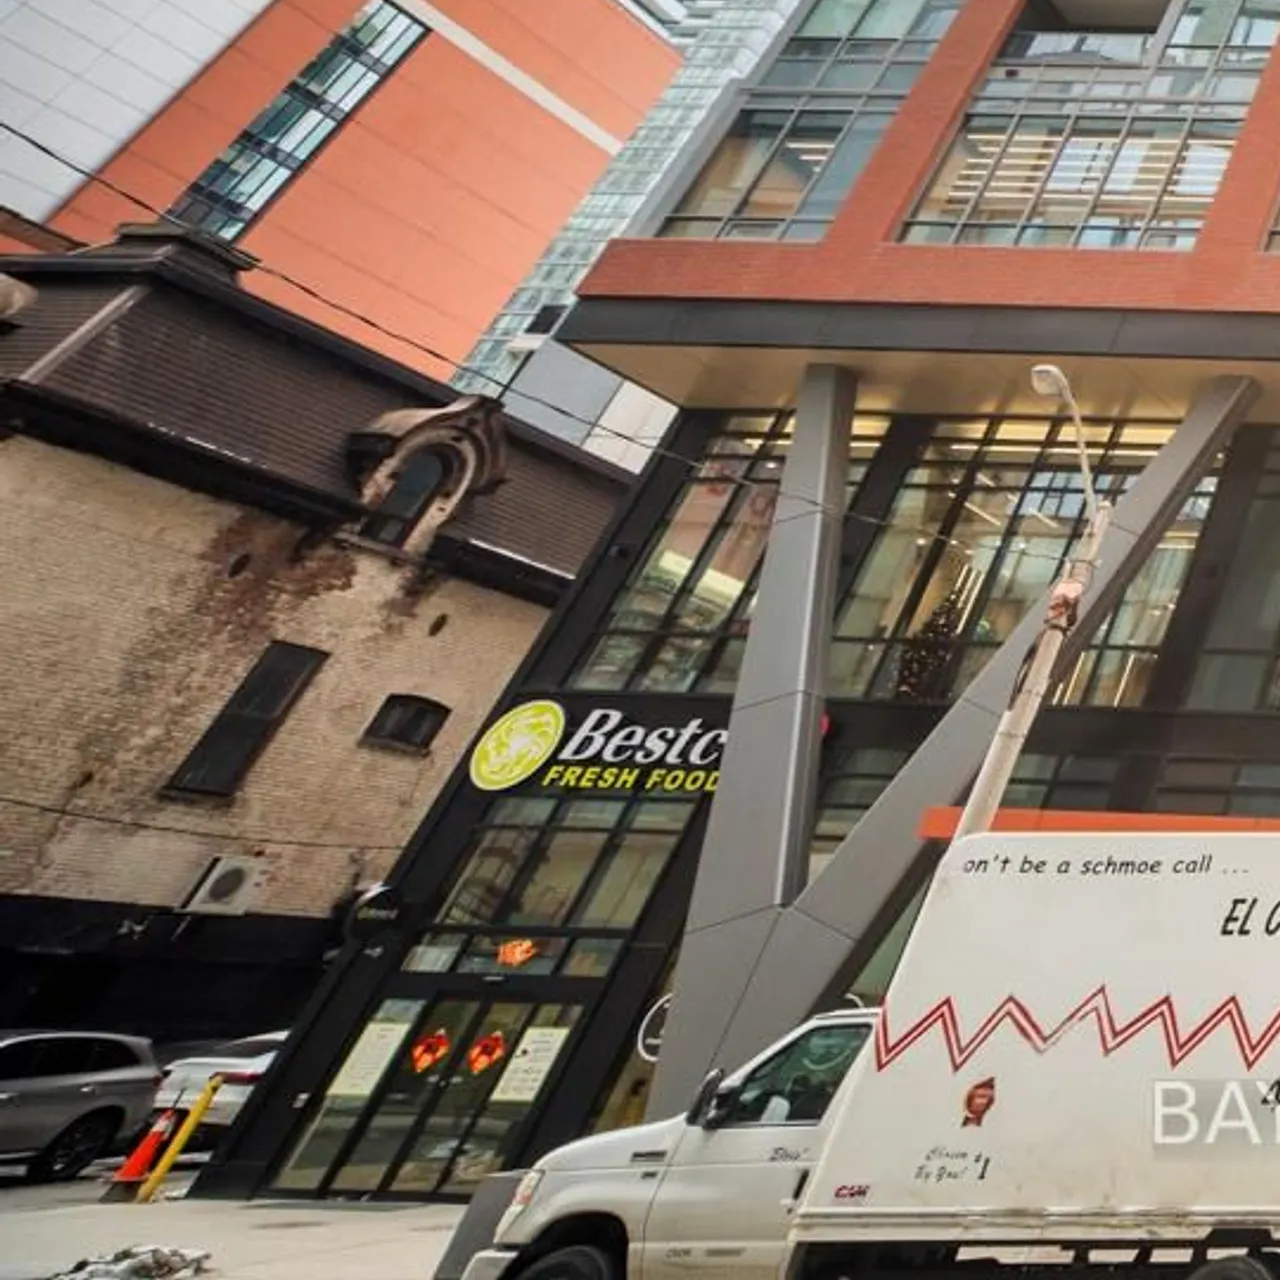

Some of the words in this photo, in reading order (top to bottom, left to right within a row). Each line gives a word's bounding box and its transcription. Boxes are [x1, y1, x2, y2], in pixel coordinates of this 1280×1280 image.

[558, 708, 728, 765] Bestc
[543, 766, 641, 789] FRESH
[645, 768, 721, 793] FOOD
[1019, 855, 1047, 874] be
[1057, 860, 1071, 874] a
[1080, 855, 1162, 875] schmoe
[1172, 853, 1213, 874] call
[1220, 898, 1258, 936] EL
